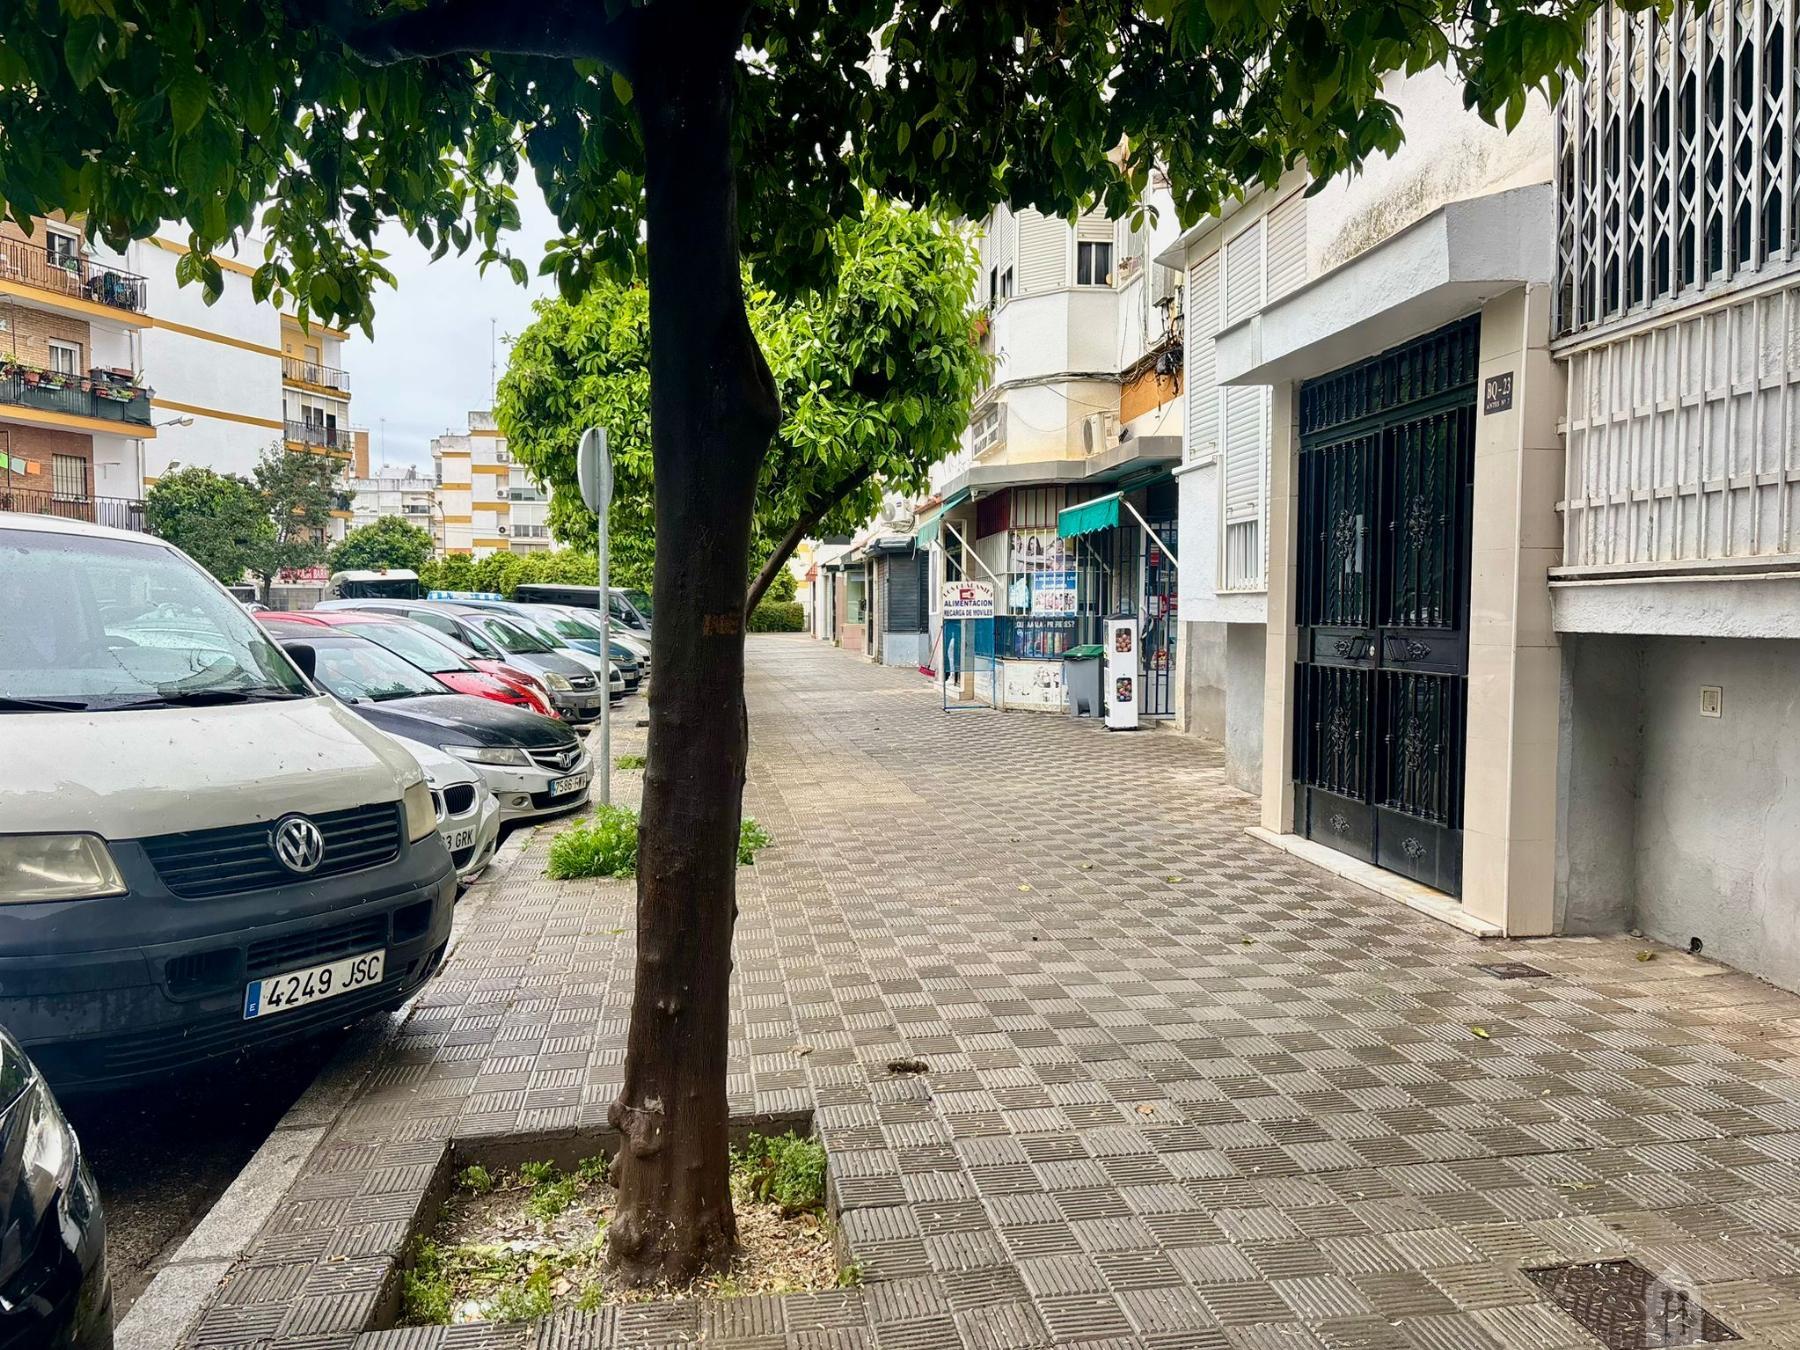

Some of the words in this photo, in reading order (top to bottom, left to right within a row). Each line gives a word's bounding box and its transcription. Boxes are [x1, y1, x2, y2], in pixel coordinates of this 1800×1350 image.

[944, 599, 993, 607] ALIMENTACION
[944, 609, 966, 617] RECARGA
[455, 829, 474, 848] GRK
[266, 968, 333, 1007] 4249
[342, 956, 380, 988] JSC
